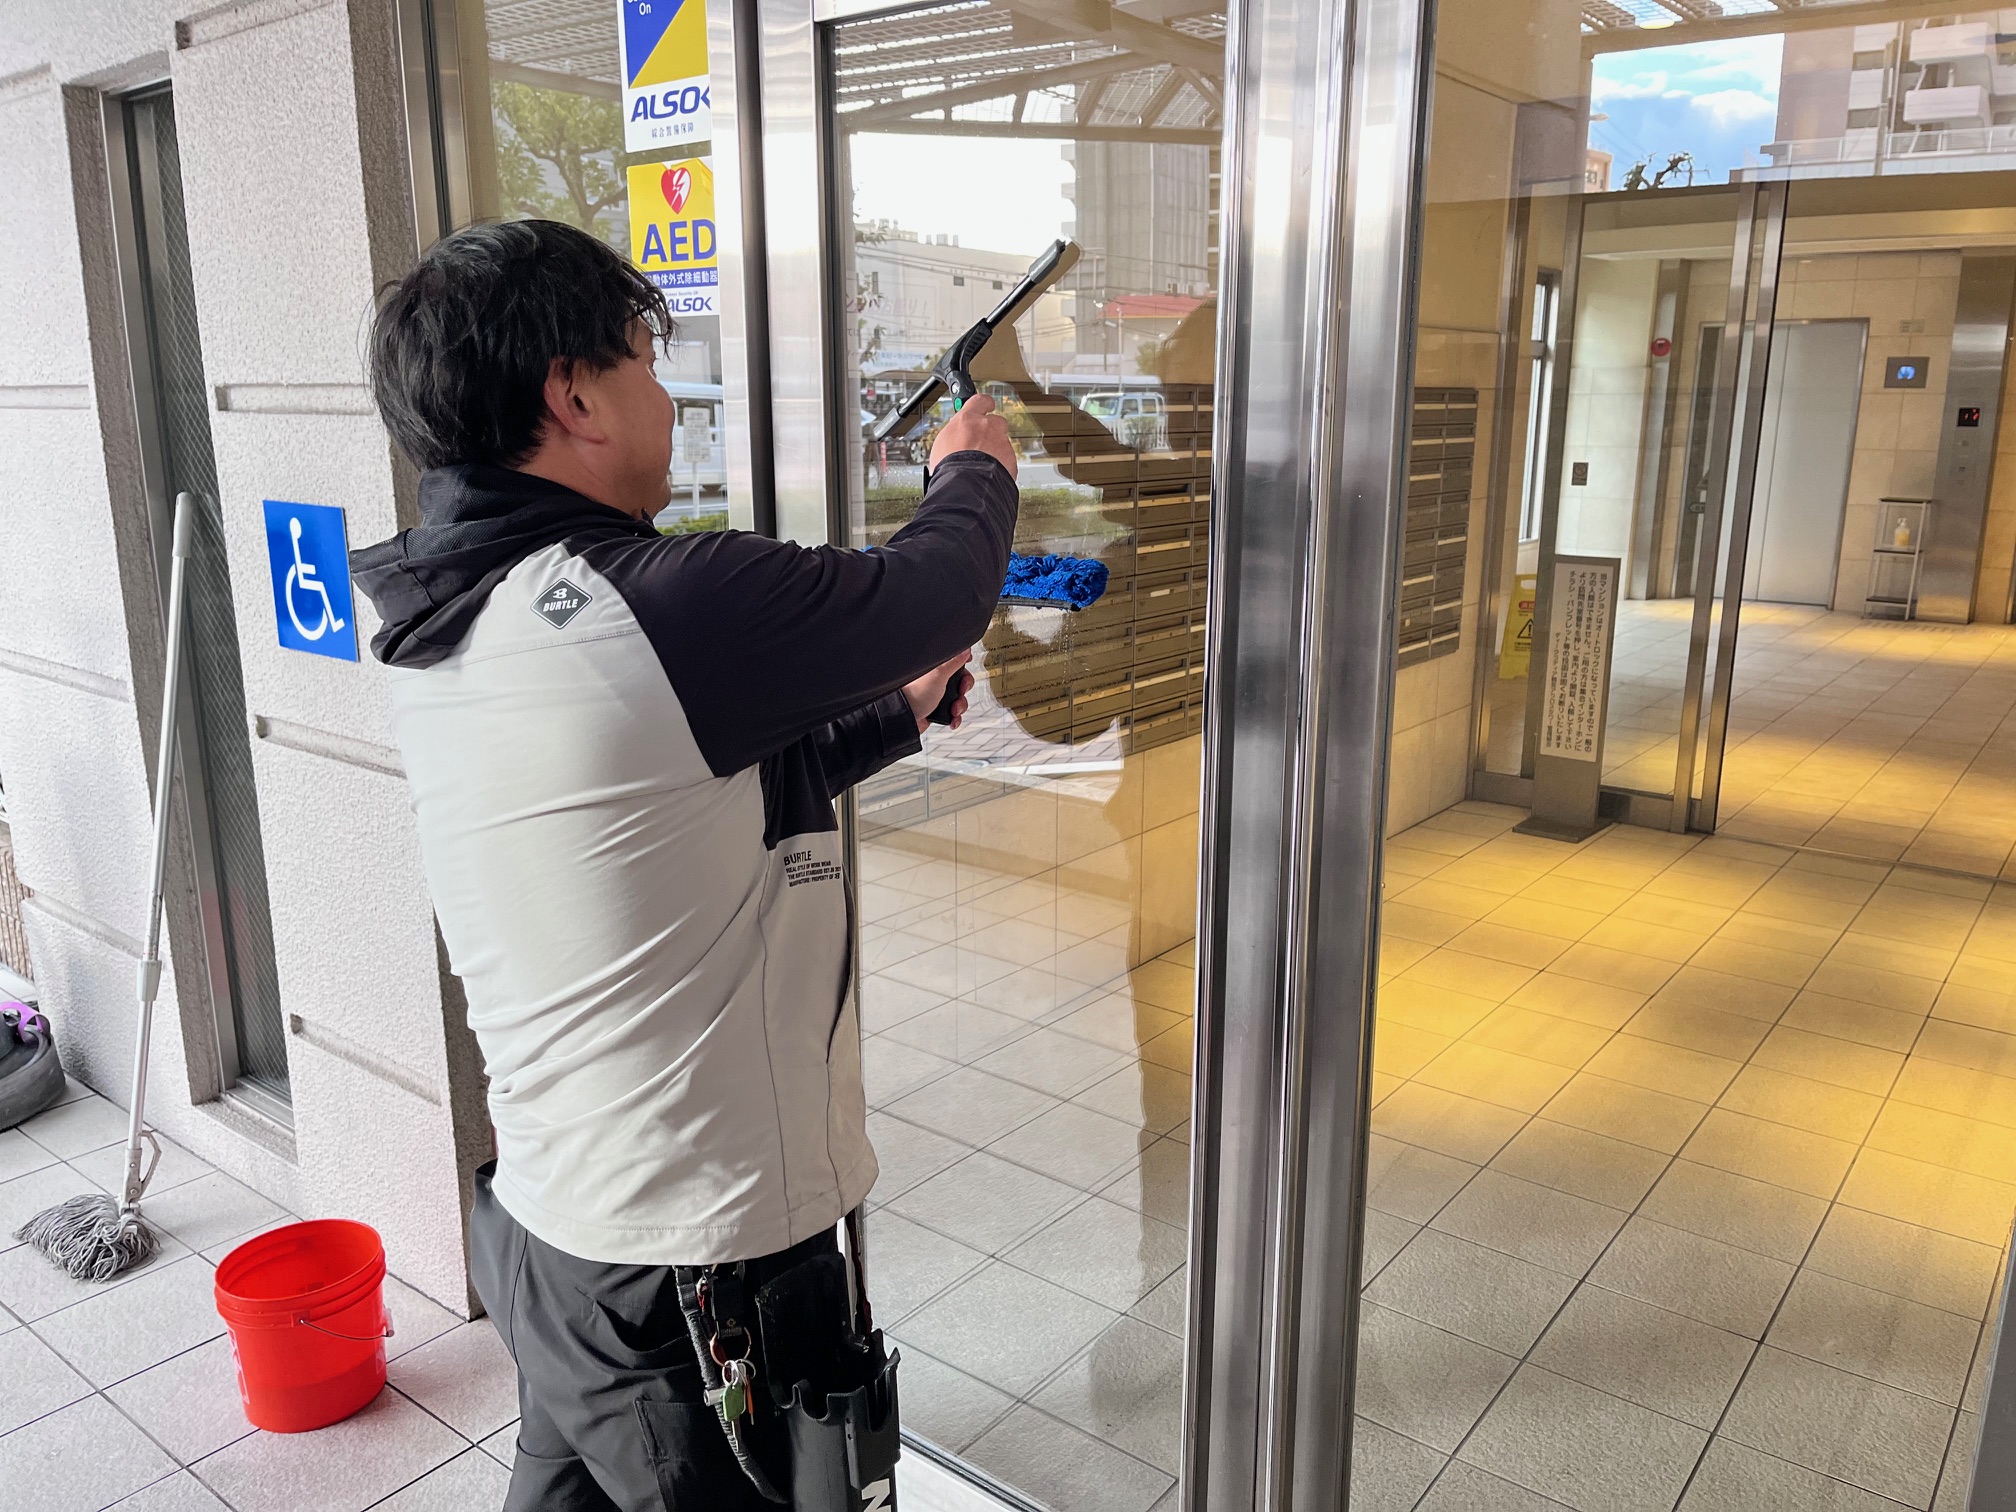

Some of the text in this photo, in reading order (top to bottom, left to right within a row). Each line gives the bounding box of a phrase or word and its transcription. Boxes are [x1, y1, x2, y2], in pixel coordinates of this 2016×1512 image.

[638, 2, 652, 16] On
[641, 218, 717, 264] AED
[668, 296, 712, 313] ALSOK
[542, 598, 579, 612] BURTLE
[783, 850, 812, 867] BURTLE
